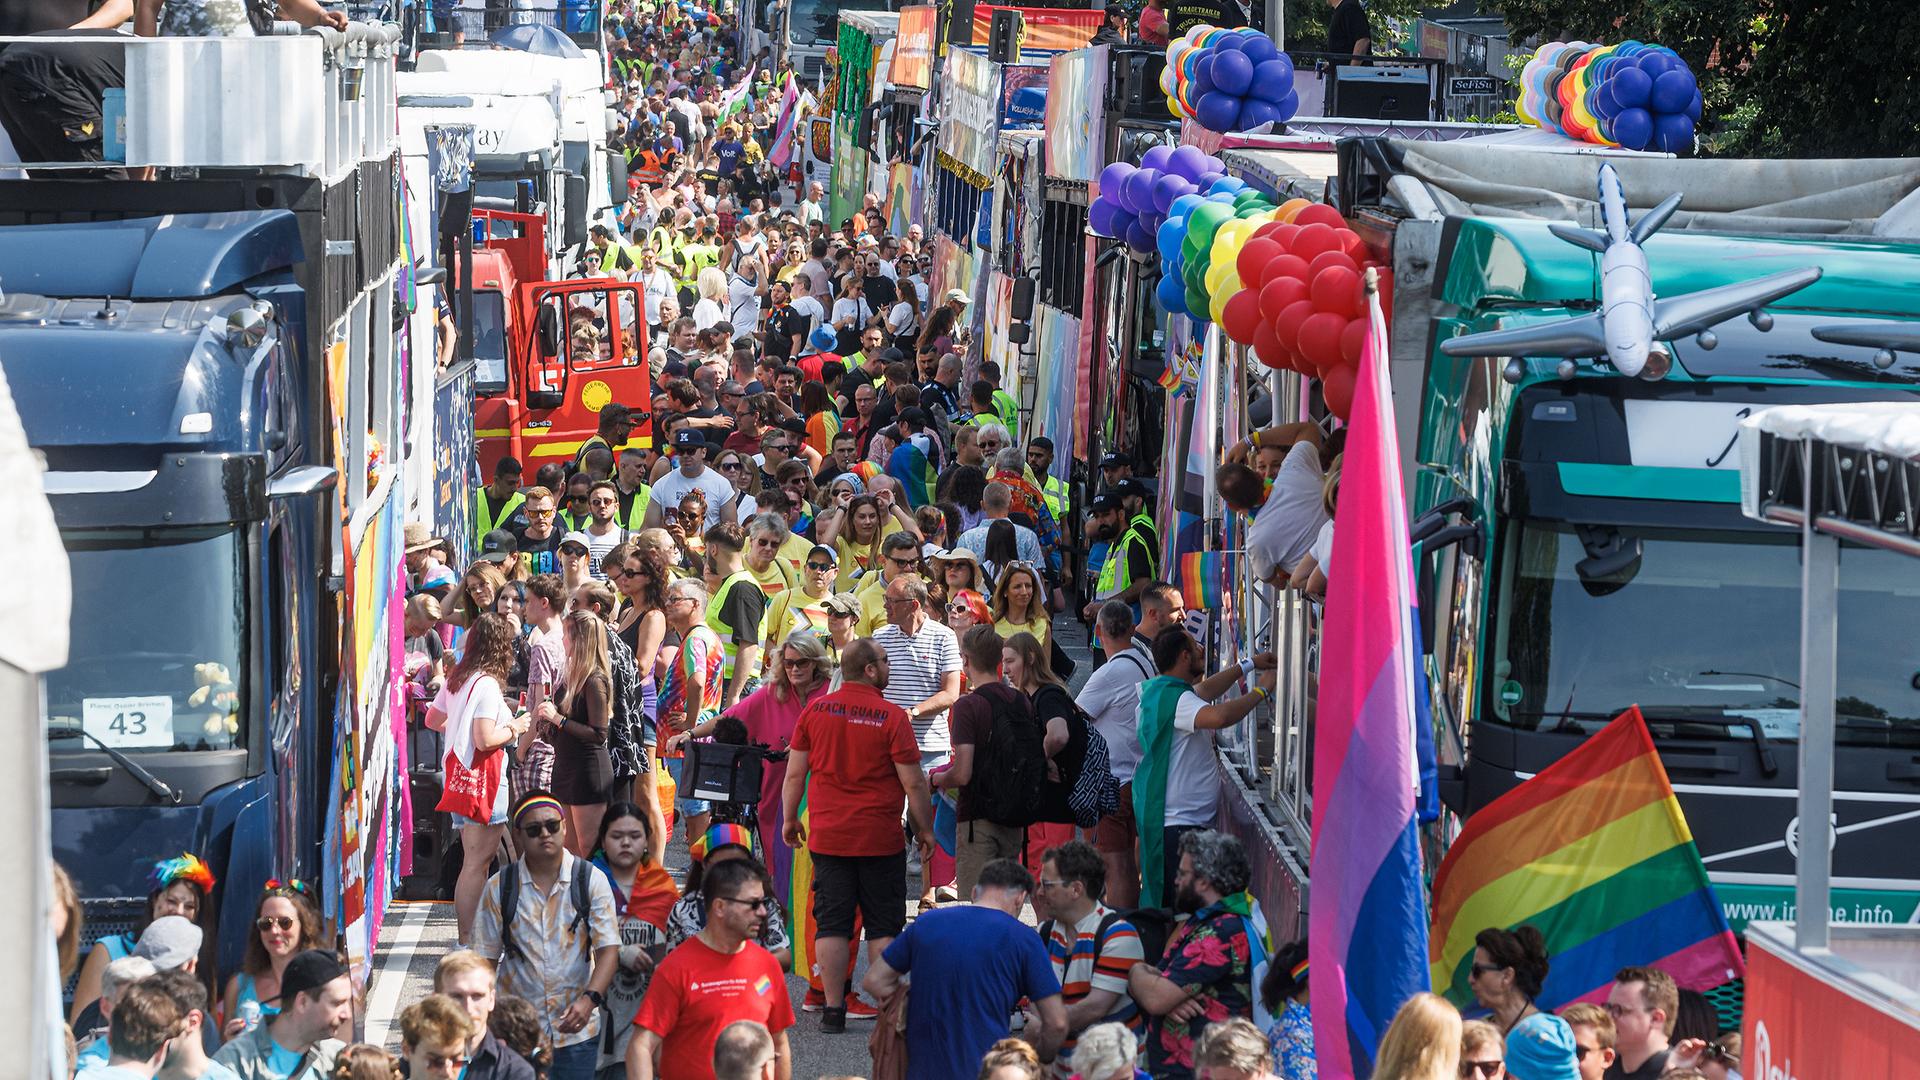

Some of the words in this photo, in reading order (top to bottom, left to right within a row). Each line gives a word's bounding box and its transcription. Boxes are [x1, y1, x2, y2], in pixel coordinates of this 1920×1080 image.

[1176, 18, 1195, 31] TRUCK
[478, 129, 504, 152] ay
[721, 149, 736, 158] Volt
[679, 433, 689, 442] K
[813, 702, 847, 715] BEACH
[850, 705, 889, 720] GUARD
[108, 711, 147, 735] 43
